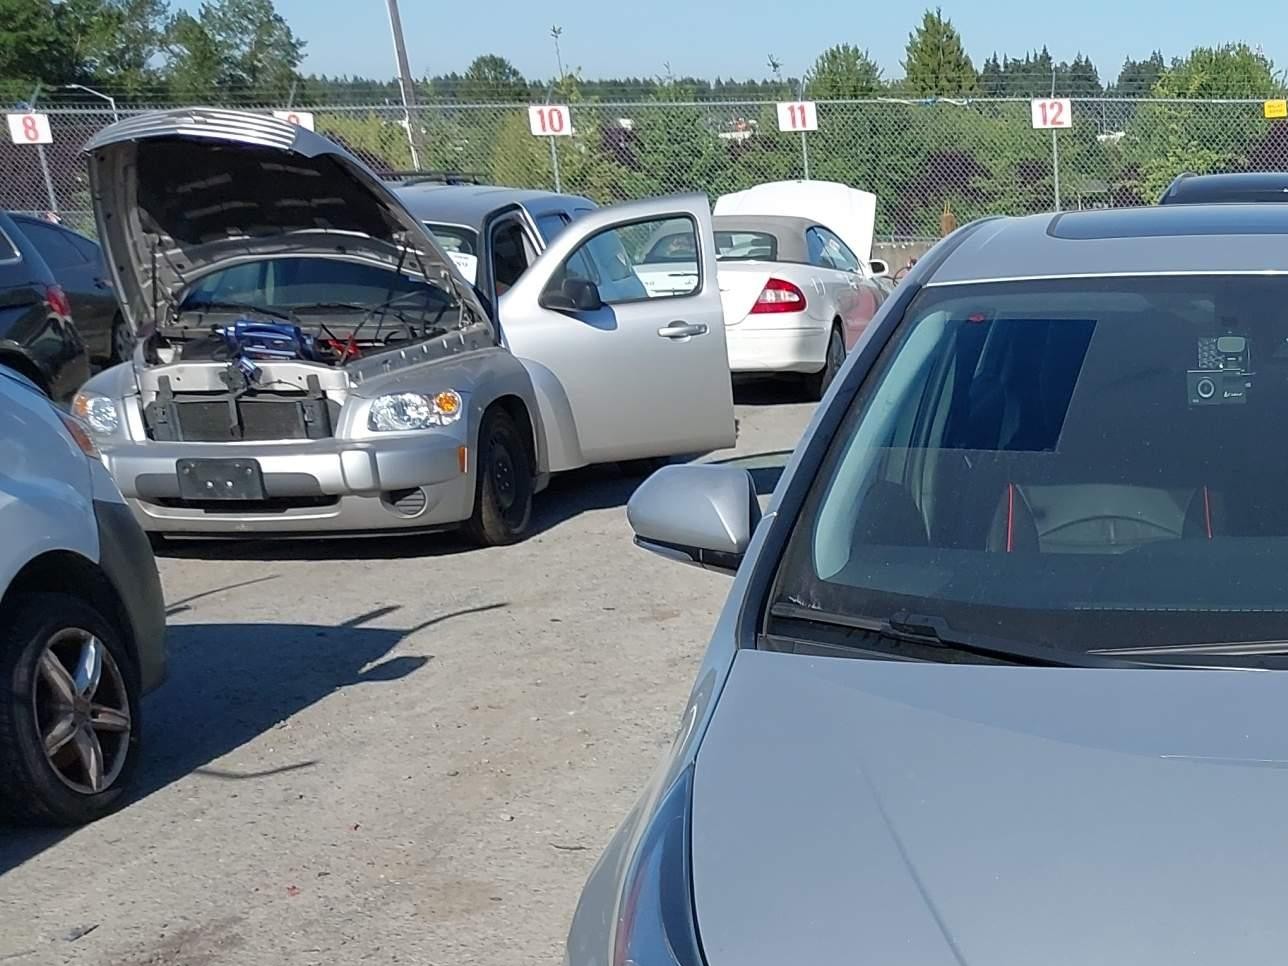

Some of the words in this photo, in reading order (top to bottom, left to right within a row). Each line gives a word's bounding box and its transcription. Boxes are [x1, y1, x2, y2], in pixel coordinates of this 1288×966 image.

[537, 108, 564, 132] 10
[787, 104, 806, 128] 11
[1039, 101, 1064, 126] 12
[22, 115, 39, 141] 8
